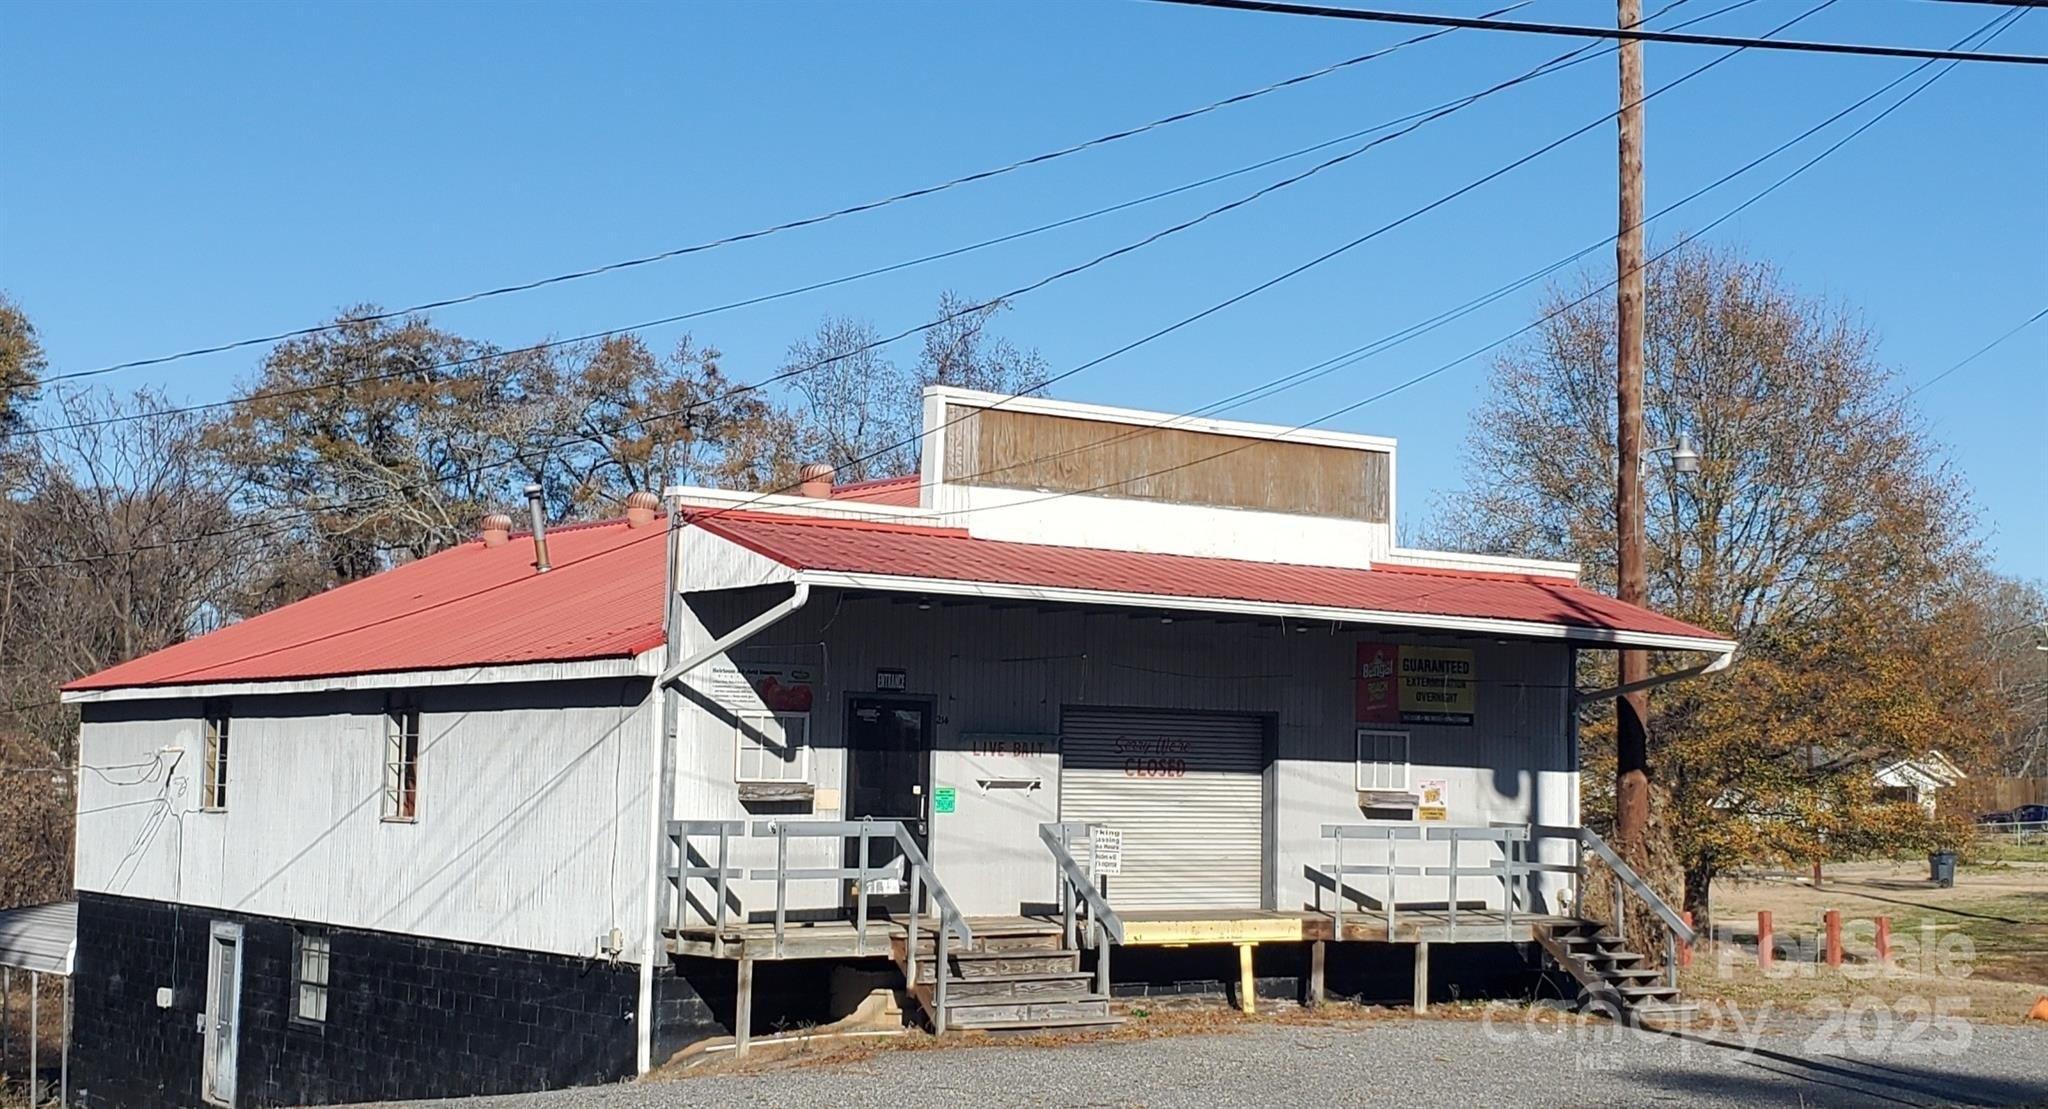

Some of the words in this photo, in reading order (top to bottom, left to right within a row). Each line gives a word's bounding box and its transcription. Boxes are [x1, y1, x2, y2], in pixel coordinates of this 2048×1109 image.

[1362, 659, 1393, 678] Bengal
[1403, 658, 1469, 674] GUARANTEED
[877, 673, 905, 689] ENTRANCE
[1406, 677, 1466, 688] EXTERMINATION
[1416, 691, 1457, 703] OVERNIGHT
[973, 741, 1006, 757] LIVE
[1013, 741, 1044, 757] BAIT
[1125, 758, 1185, 777] CLOSED
